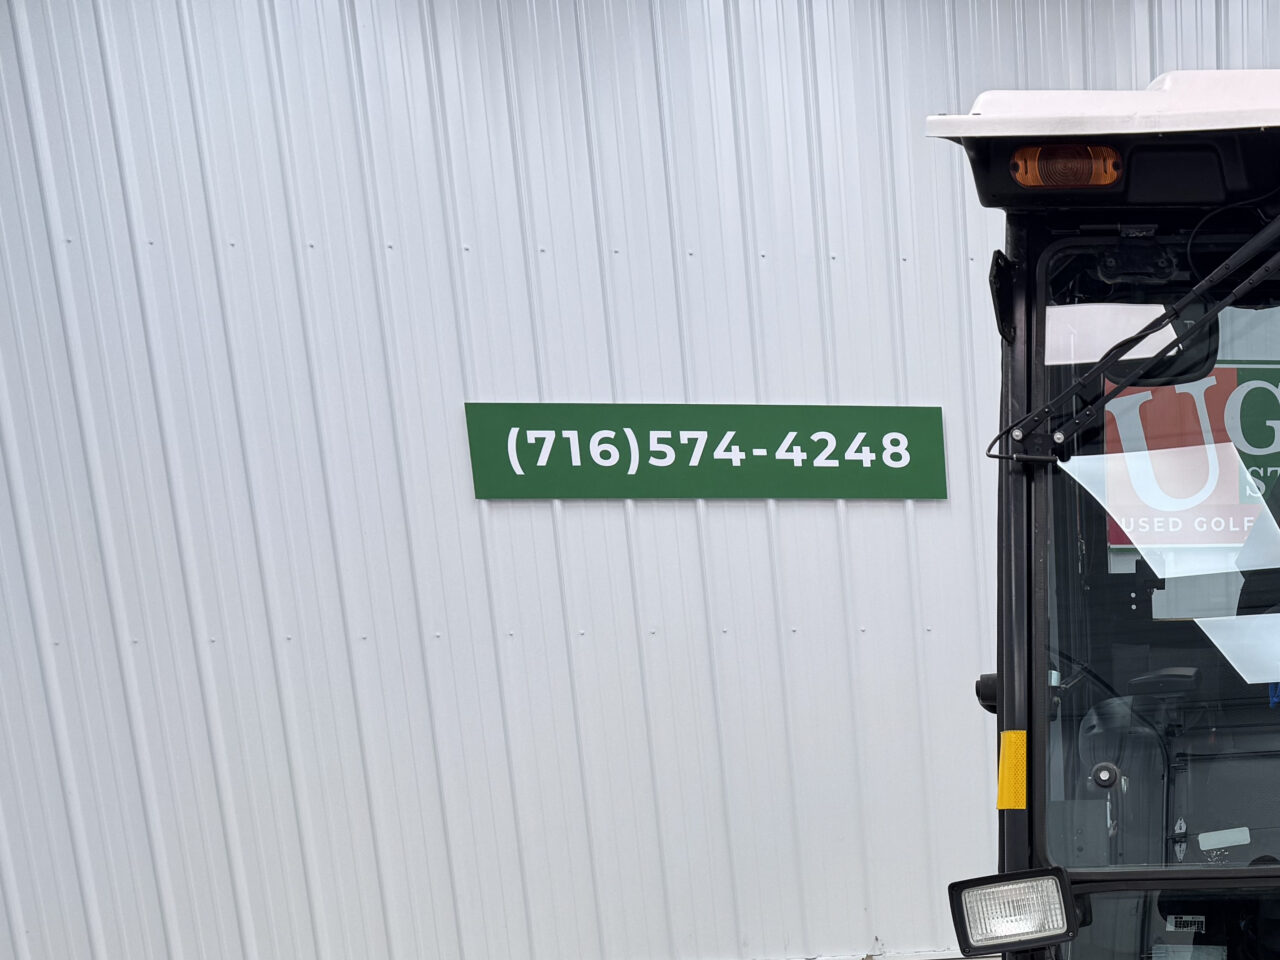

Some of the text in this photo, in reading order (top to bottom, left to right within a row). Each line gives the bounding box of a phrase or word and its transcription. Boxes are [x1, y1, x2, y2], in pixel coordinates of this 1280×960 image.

[507, 427, 911, 475] (716)574-4248
[1121, 516, 1183, 533] USED
[1194, 515, 1255, 533] GOLF
